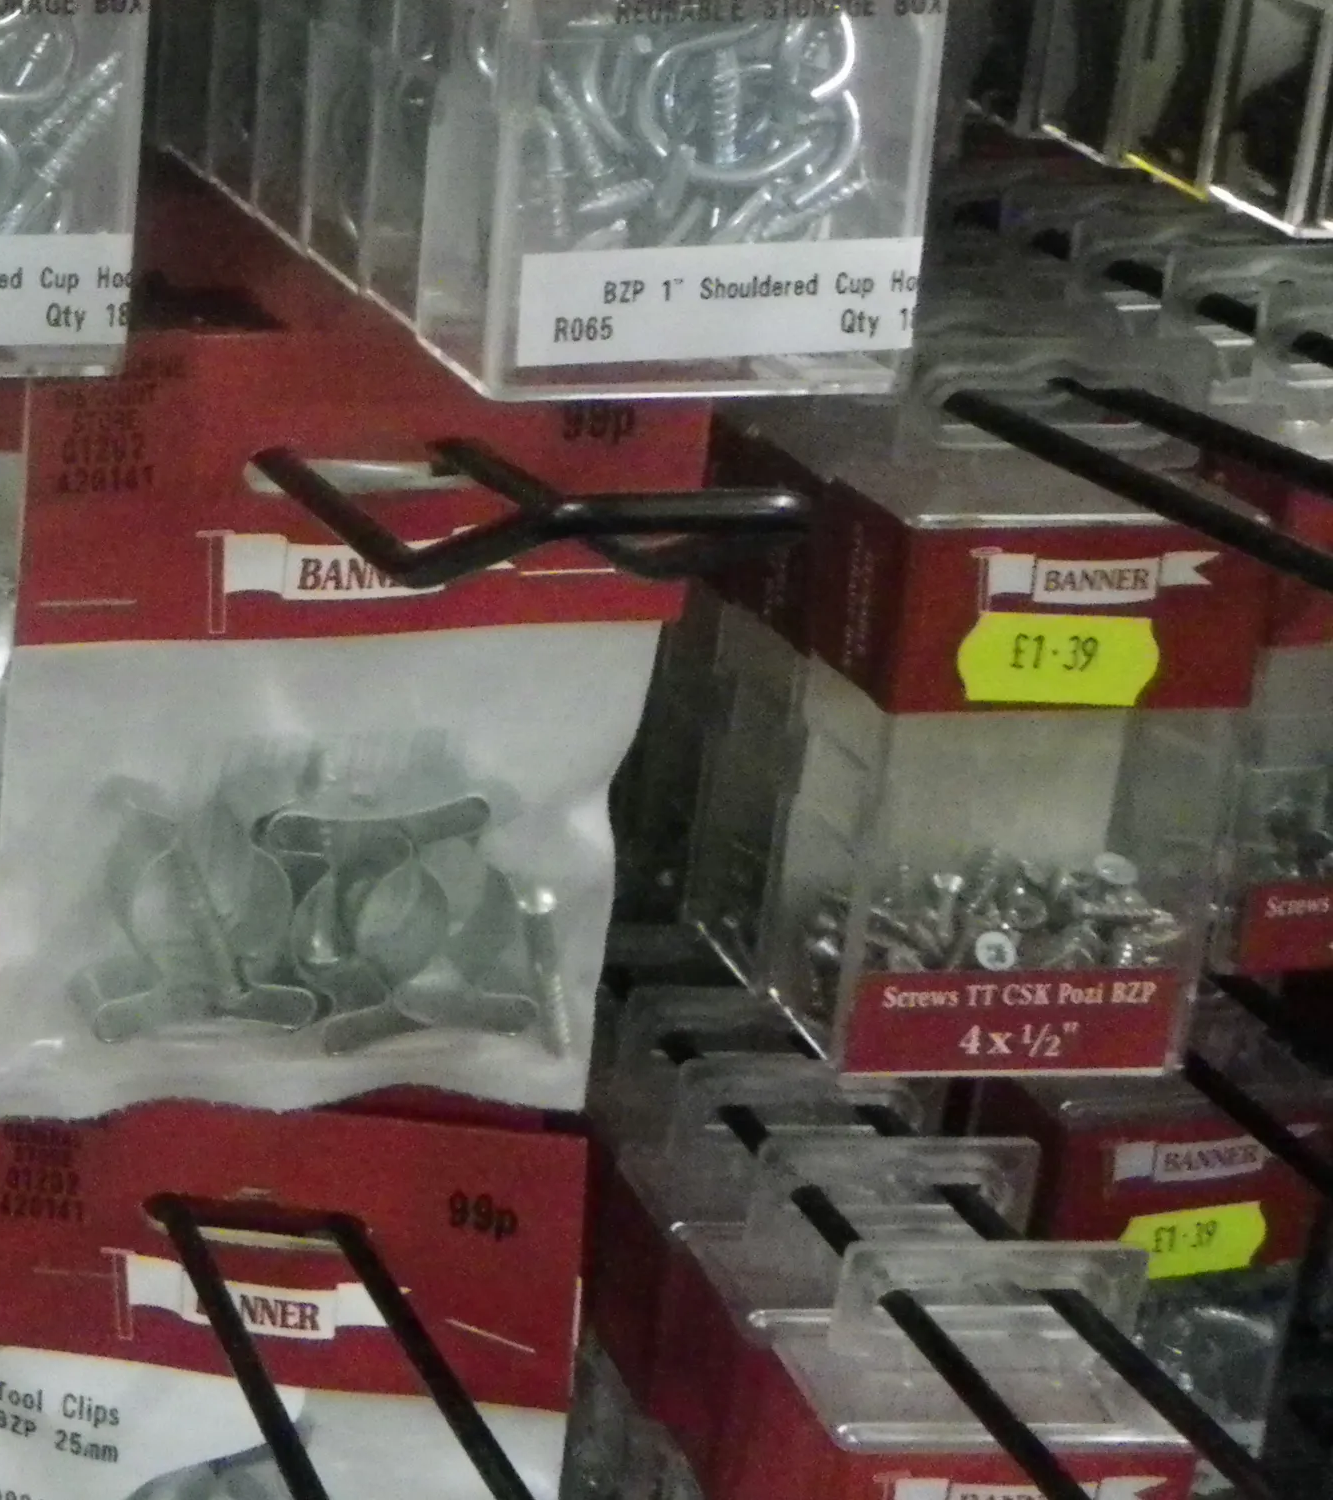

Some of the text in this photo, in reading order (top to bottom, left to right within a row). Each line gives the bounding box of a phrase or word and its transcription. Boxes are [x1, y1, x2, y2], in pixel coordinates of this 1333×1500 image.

[39, 267, 80, 293] Cup
[97, 266, 133, 289] Hoo
[603, 279, 645, 304] BZP
[700, 273, 819, 301] Shouldered
[835, 272, 874, 298] Cup
[46, 303, 86, 331] Qty
[554, 316, 613, 343] R065
[840, 309, 880, 338] Qty
[1044, 567, 1150, 592] BANNER
[883, 981, 1157, 1009] Screws TT CSK Pozi BZP
[1163, 1145, 1260, 1173] BANNER
[196, 1294, 320, 1330] NNER
[62, 1393, 120, 1428] Clips
